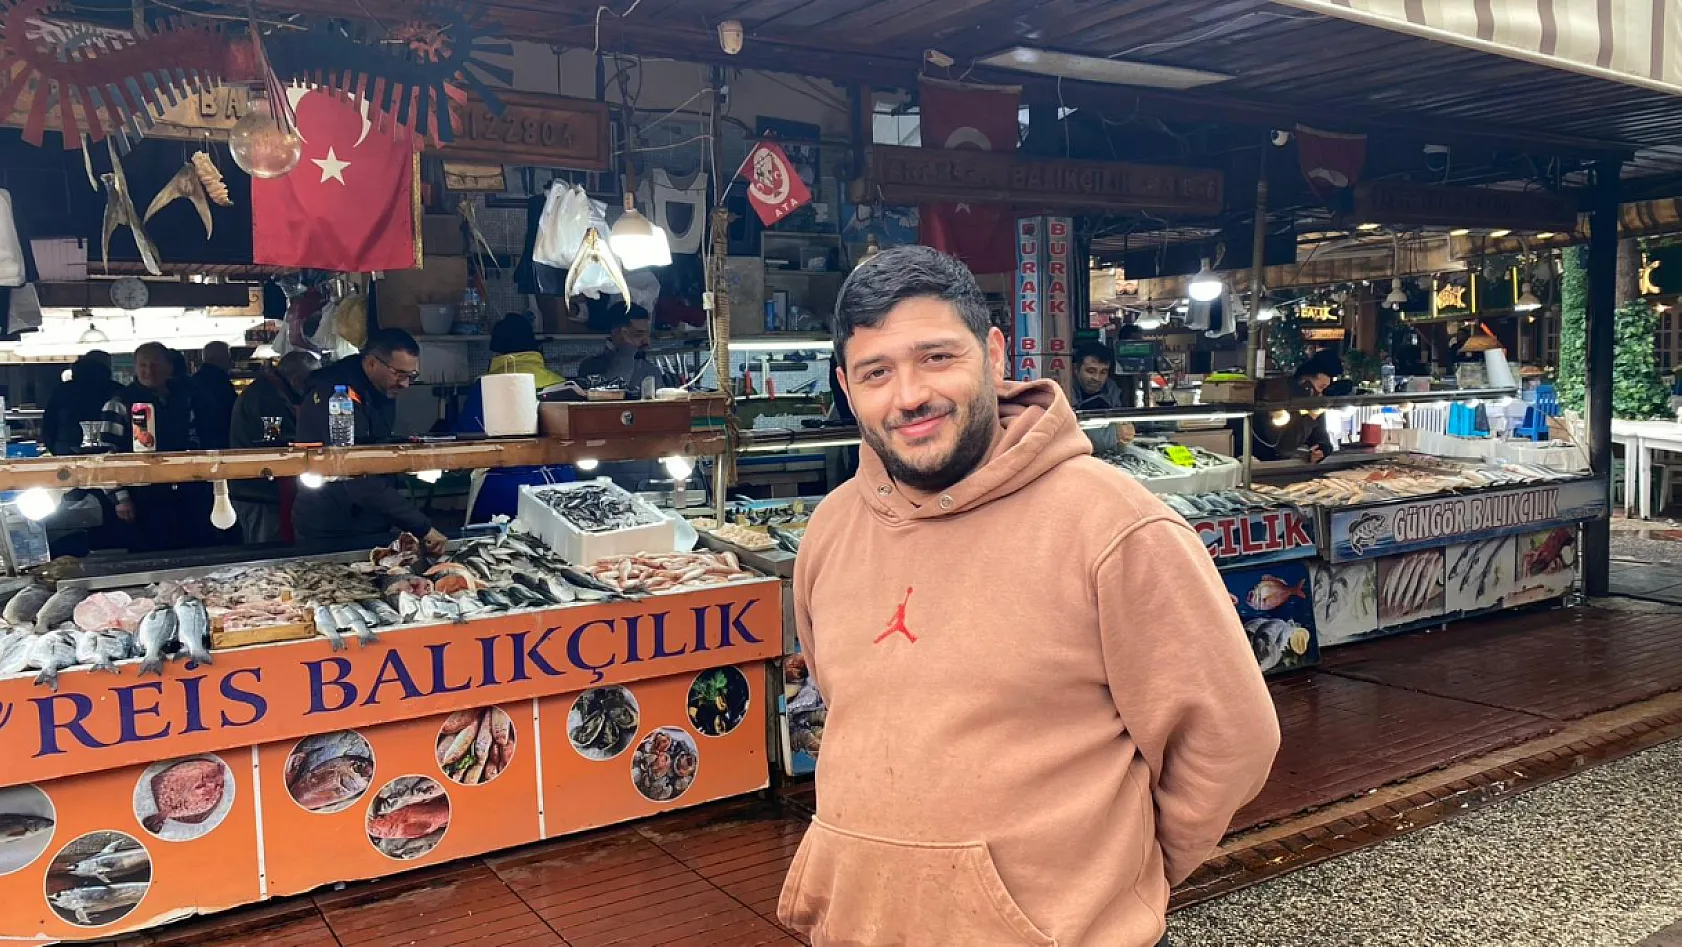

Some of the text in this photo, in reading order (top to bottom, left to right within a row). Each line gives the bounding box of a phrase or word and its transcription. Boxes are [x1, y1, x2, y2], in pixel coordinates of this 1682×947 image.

[775, 198, 799, 217] ATA
[1050, 223, 1066, 313] BURAK
[1021, 338, 1037, 382] BA
[1394, 501, 1466, 541] GÜNGÖR
[26, 598, 764, 758] REİS BALIKÇILIK
